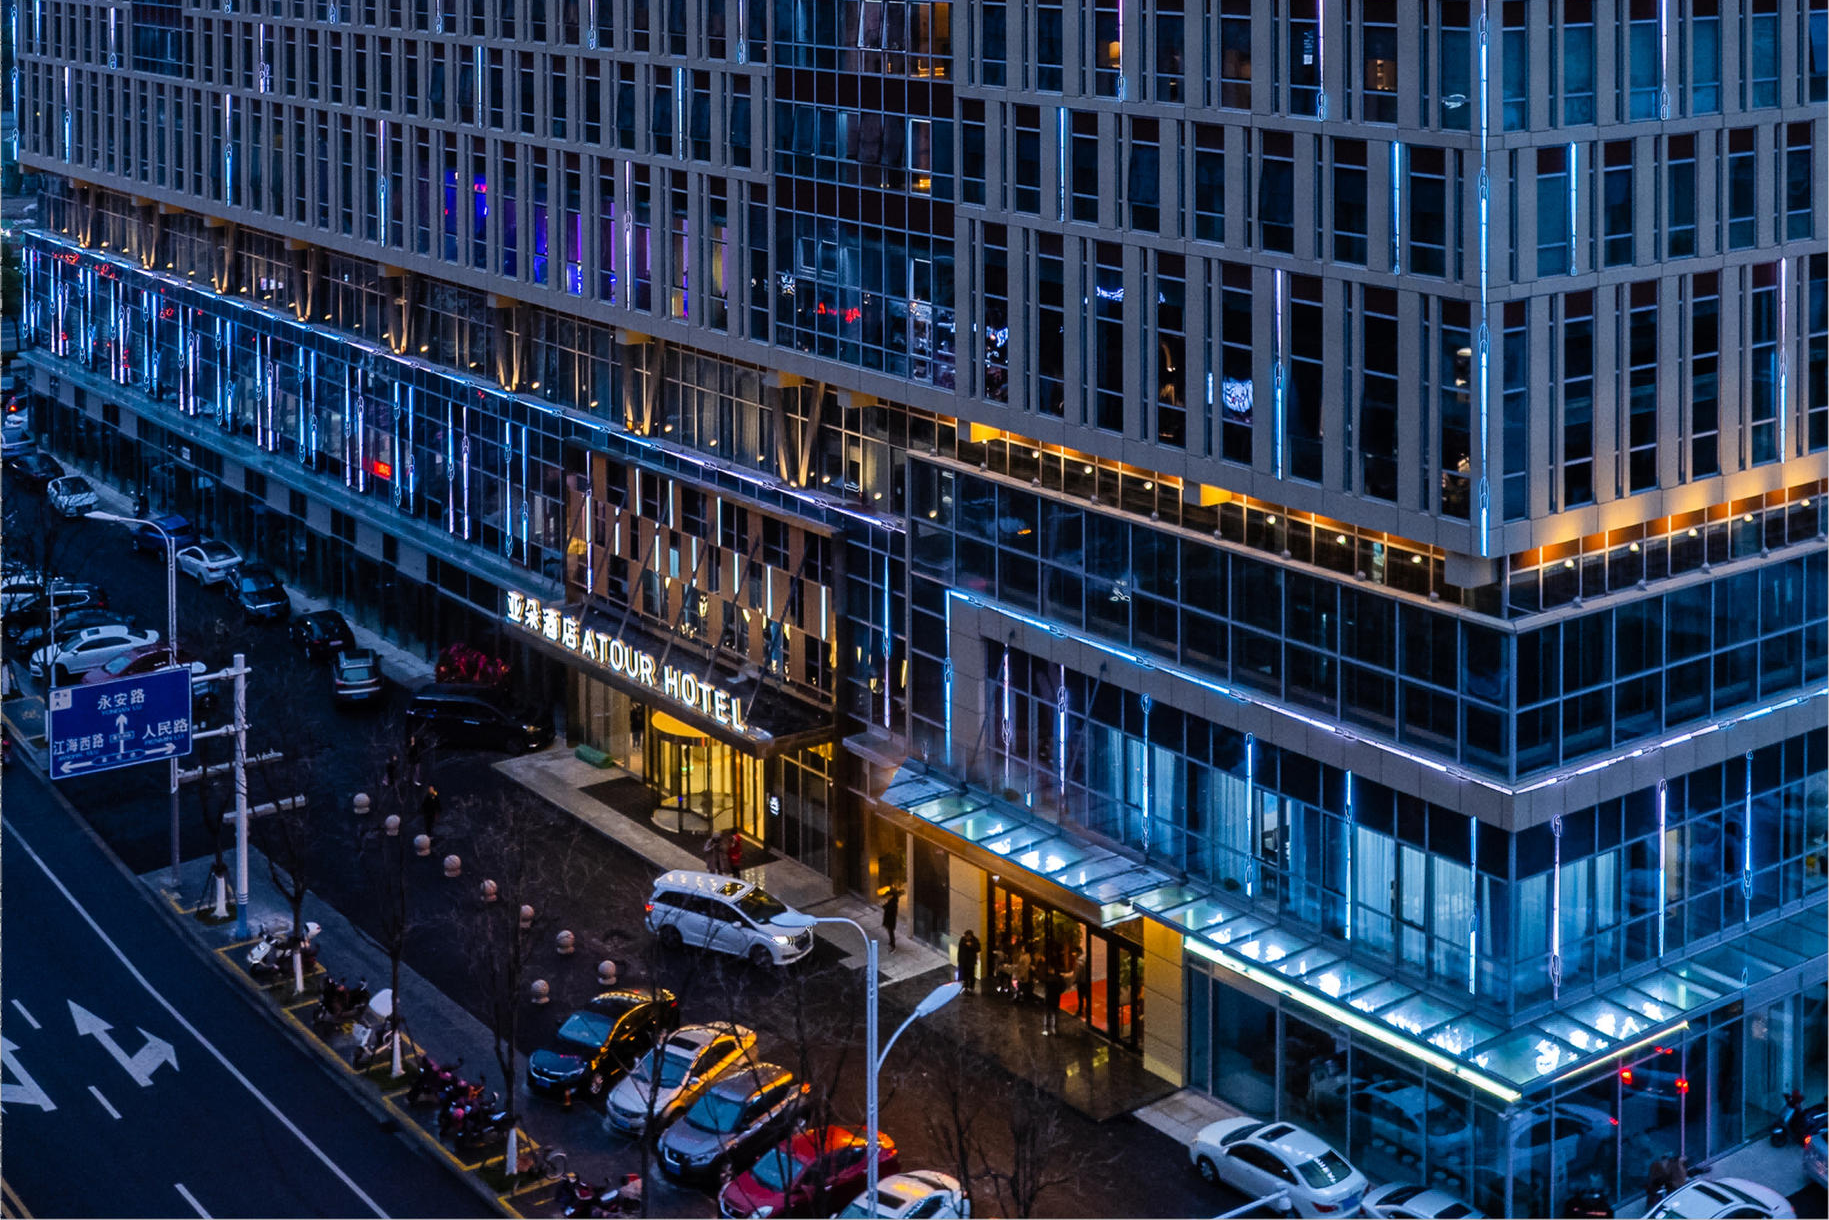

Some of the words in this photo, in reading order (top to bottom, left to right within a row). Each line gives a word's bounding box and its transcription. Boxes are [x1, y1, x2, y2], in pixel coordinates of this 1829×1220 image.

[507, 589, 581, 651] 亚朵酒店
[582, 627, 657, 687] ATOUR
[663, 664, 749, 733] HOTEL
[97, 688, 145, 710] 永安路
[142, 718, 189, 740] 人民路
[53, 733, 105, 756] 江海西路
